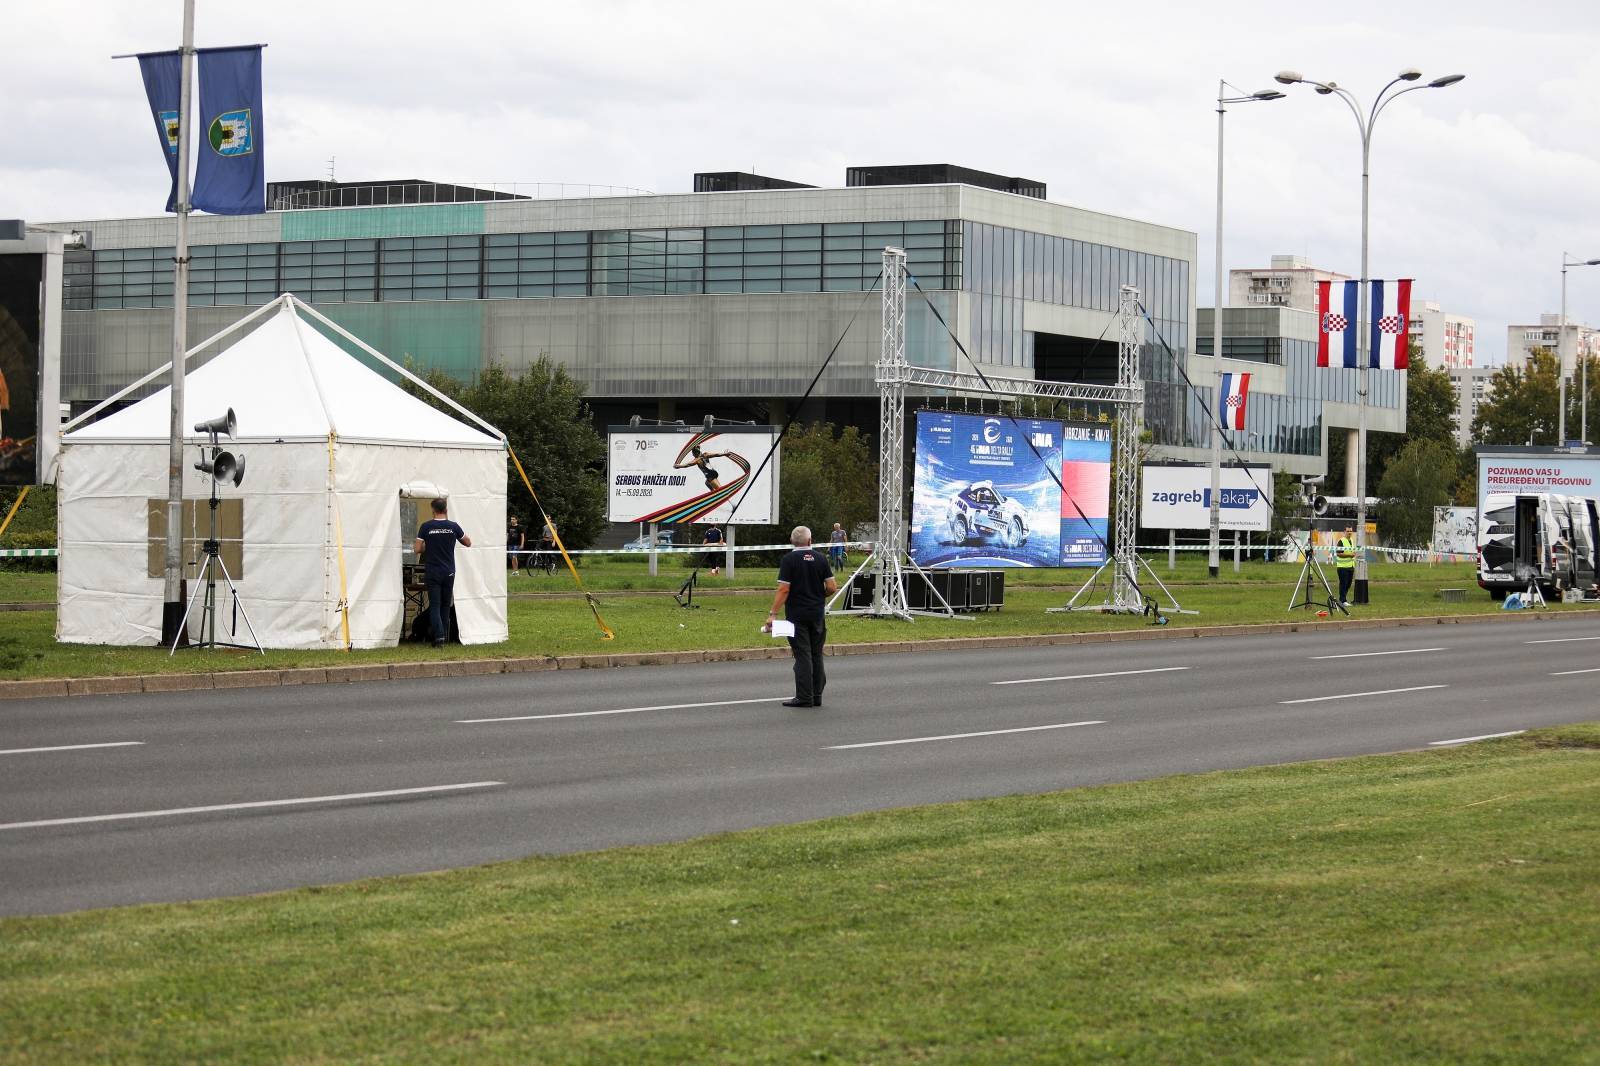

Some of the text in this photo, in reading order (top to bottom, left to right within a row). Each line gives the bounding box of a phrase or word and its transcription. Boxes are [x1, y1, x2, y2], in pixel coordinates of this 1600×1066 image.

[1064, 427, 1090, 441] UBRZANJE
[635, 440, 647, 451] 70
[1487, 467, 1534, 475] POZIVAMO
[1535, 468, 1552, 476] VAS
[615, 475, 641, 485] SERBUS
[642, 473, 668, 486] HANŽEK
[1487, 476, 1592, 486] PREUREĐENU TRGOVINU
[1152, 490, 1251, 505] zagreb akat
